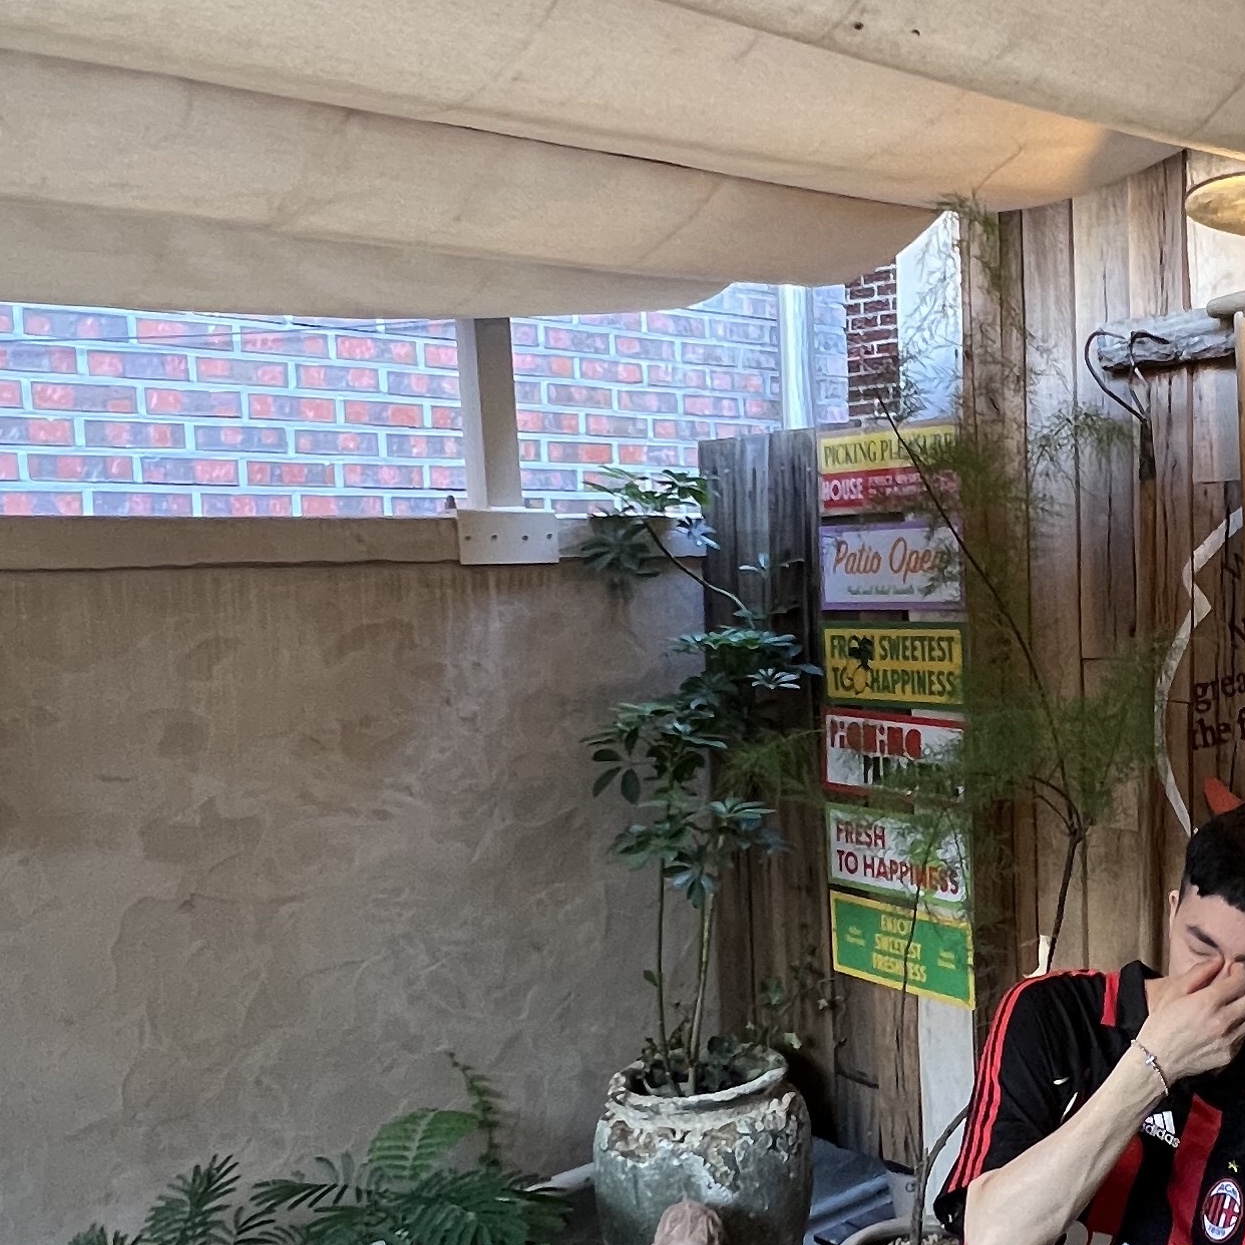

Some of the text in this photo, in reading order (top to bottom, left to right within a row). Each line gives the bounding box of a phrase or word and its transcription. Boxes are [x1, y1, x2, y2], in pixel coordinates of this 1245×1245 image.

[824, 440, 877, 467] PICKING
[833, 538, 882, 574] Patio
[879, 635, 955, 662] SWEETEST
[869, 667, 957, 698] HAPPINESS
[836, 820, 886, 850] FRESH
[836, 849, 960, 895] TO HAPPINESS
[1142, 1122, 1181, 1148] didas
